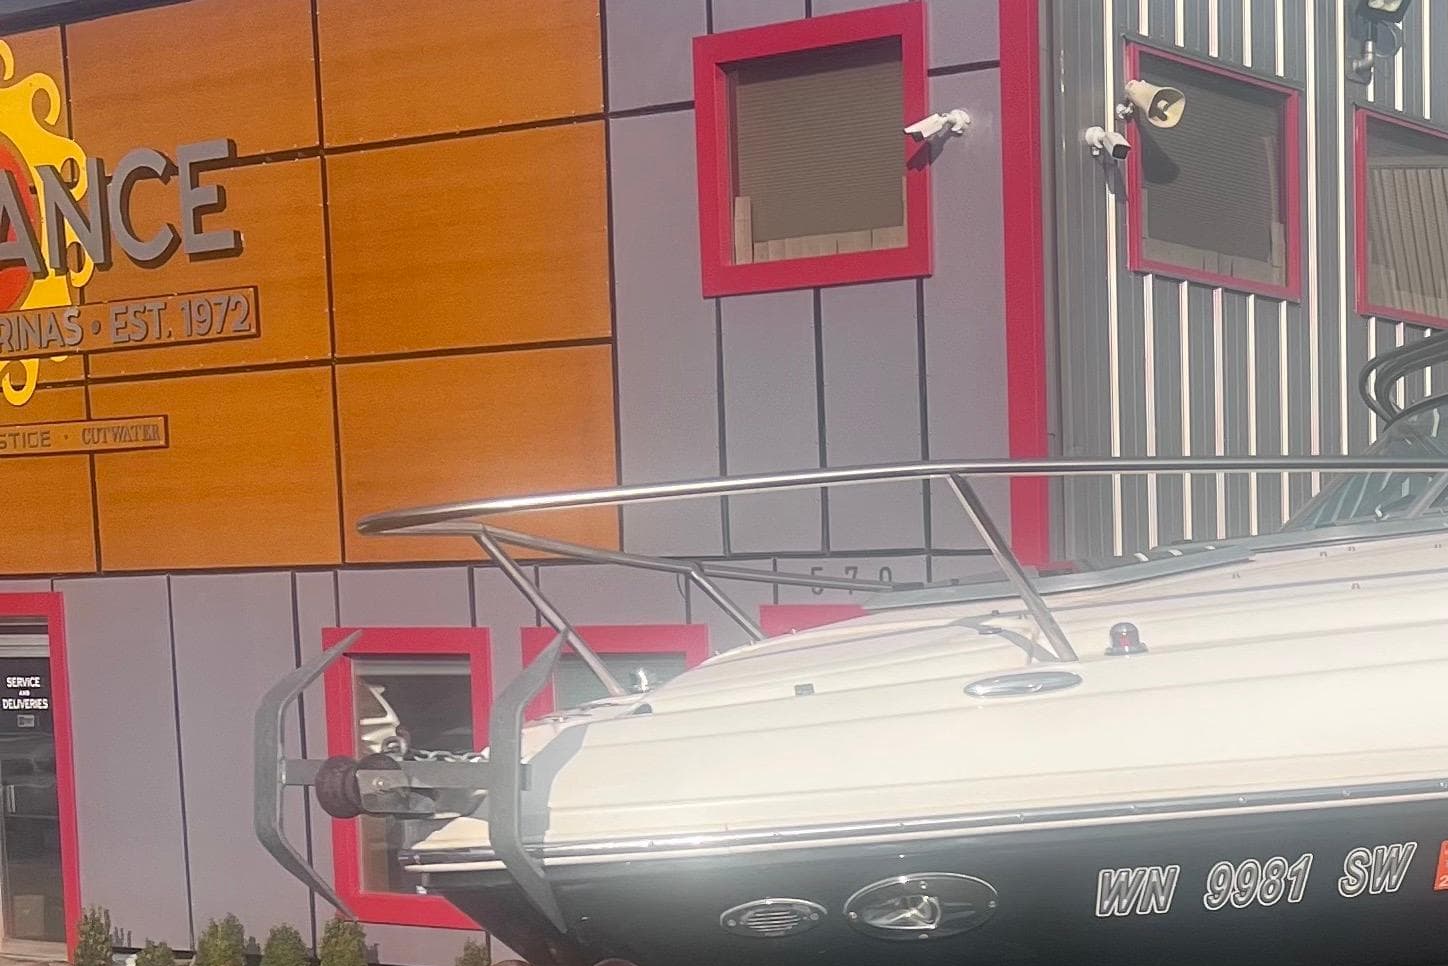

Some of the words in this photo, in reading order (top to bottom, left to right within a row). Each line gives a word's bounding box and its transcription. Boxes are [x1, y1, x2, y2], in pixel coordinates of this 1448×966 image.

[111, 303, 173, 343] EST.
[181, 295, 250, 336] 1972
[82, 424, 160, 445] CUTWATER
[6, 677, 41, 688] SERVICE
[2, 698, 49, 710] DELIVERIES
[1095, 865, 1180, 917] WN
[1203, 853, 1313, 911] 9981
[1338, 842, 1418, 897] SW
